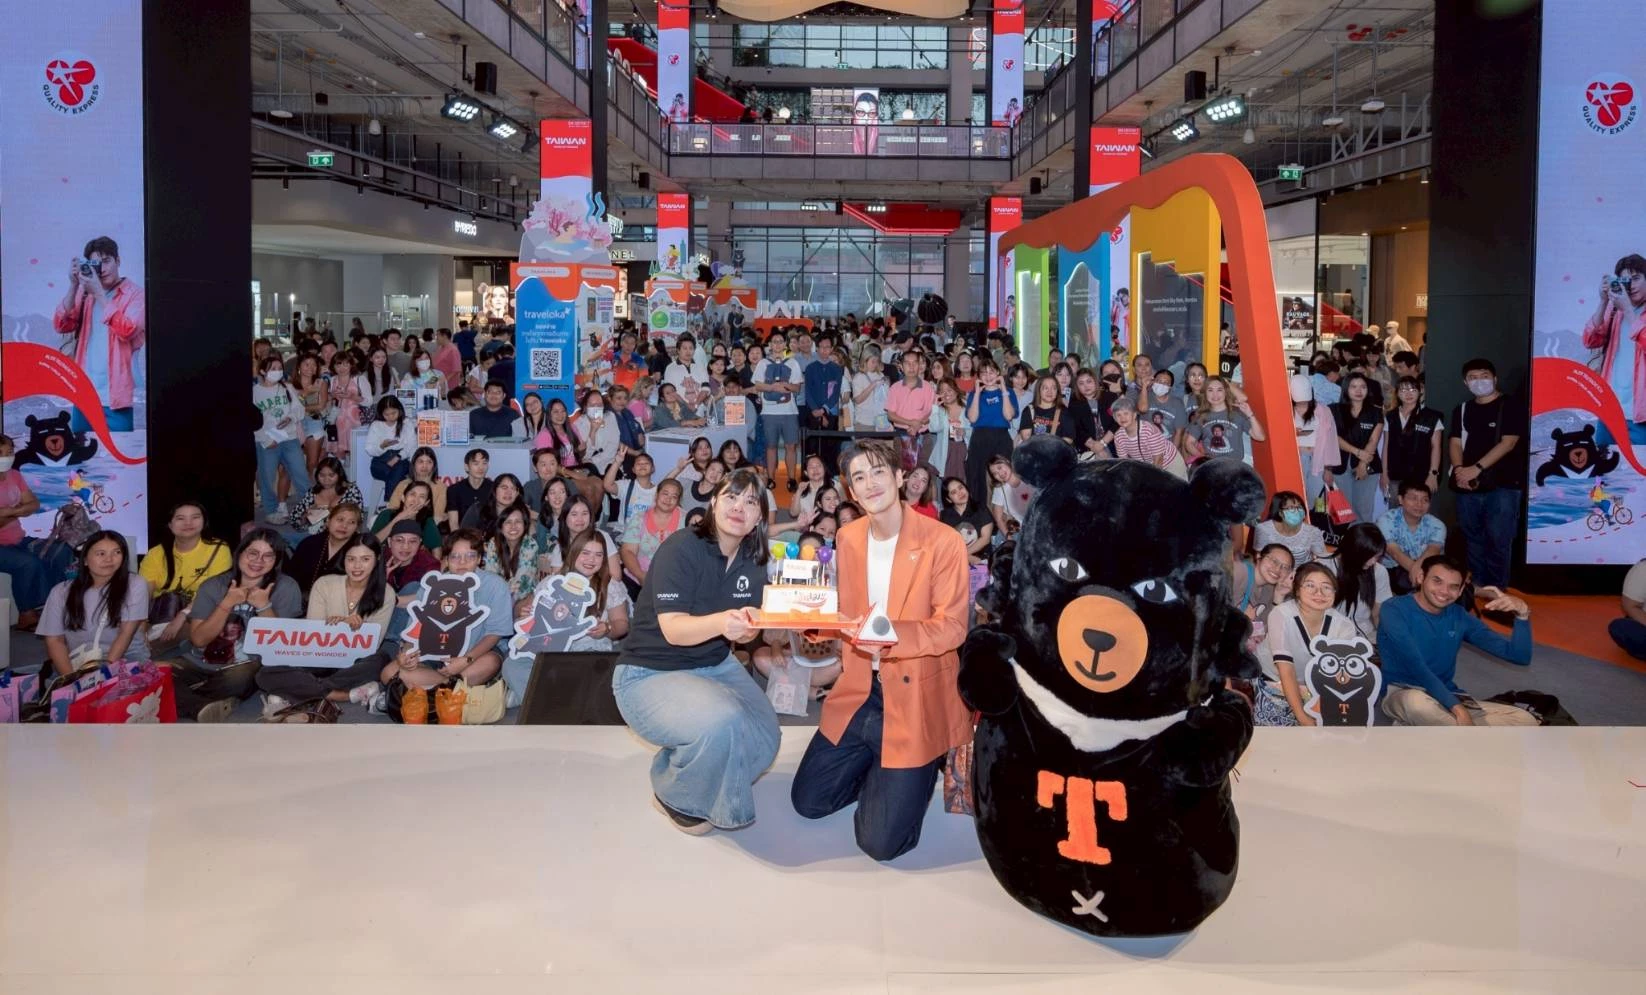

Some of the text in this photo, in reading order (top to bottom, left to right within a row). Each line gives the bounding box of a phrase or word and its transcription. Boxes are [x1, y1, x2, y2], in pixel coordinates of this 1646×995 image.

[43, 84, 99, 114] QUALITY EXPRESS
[1582, 105, 1636, 134] QUALITY EXPRESS
[544, 137, 587, 145] TAIWAN
[1094, 144, 1136, 152] TAIWAN
[524, 309, 566, 319] traveloka
[252, 629, 374, 649] TAIWAN
[440, 633, 449, 644] T
[1339, 703, 1350, 714] T
[1036, 770, 1128, 866] T
